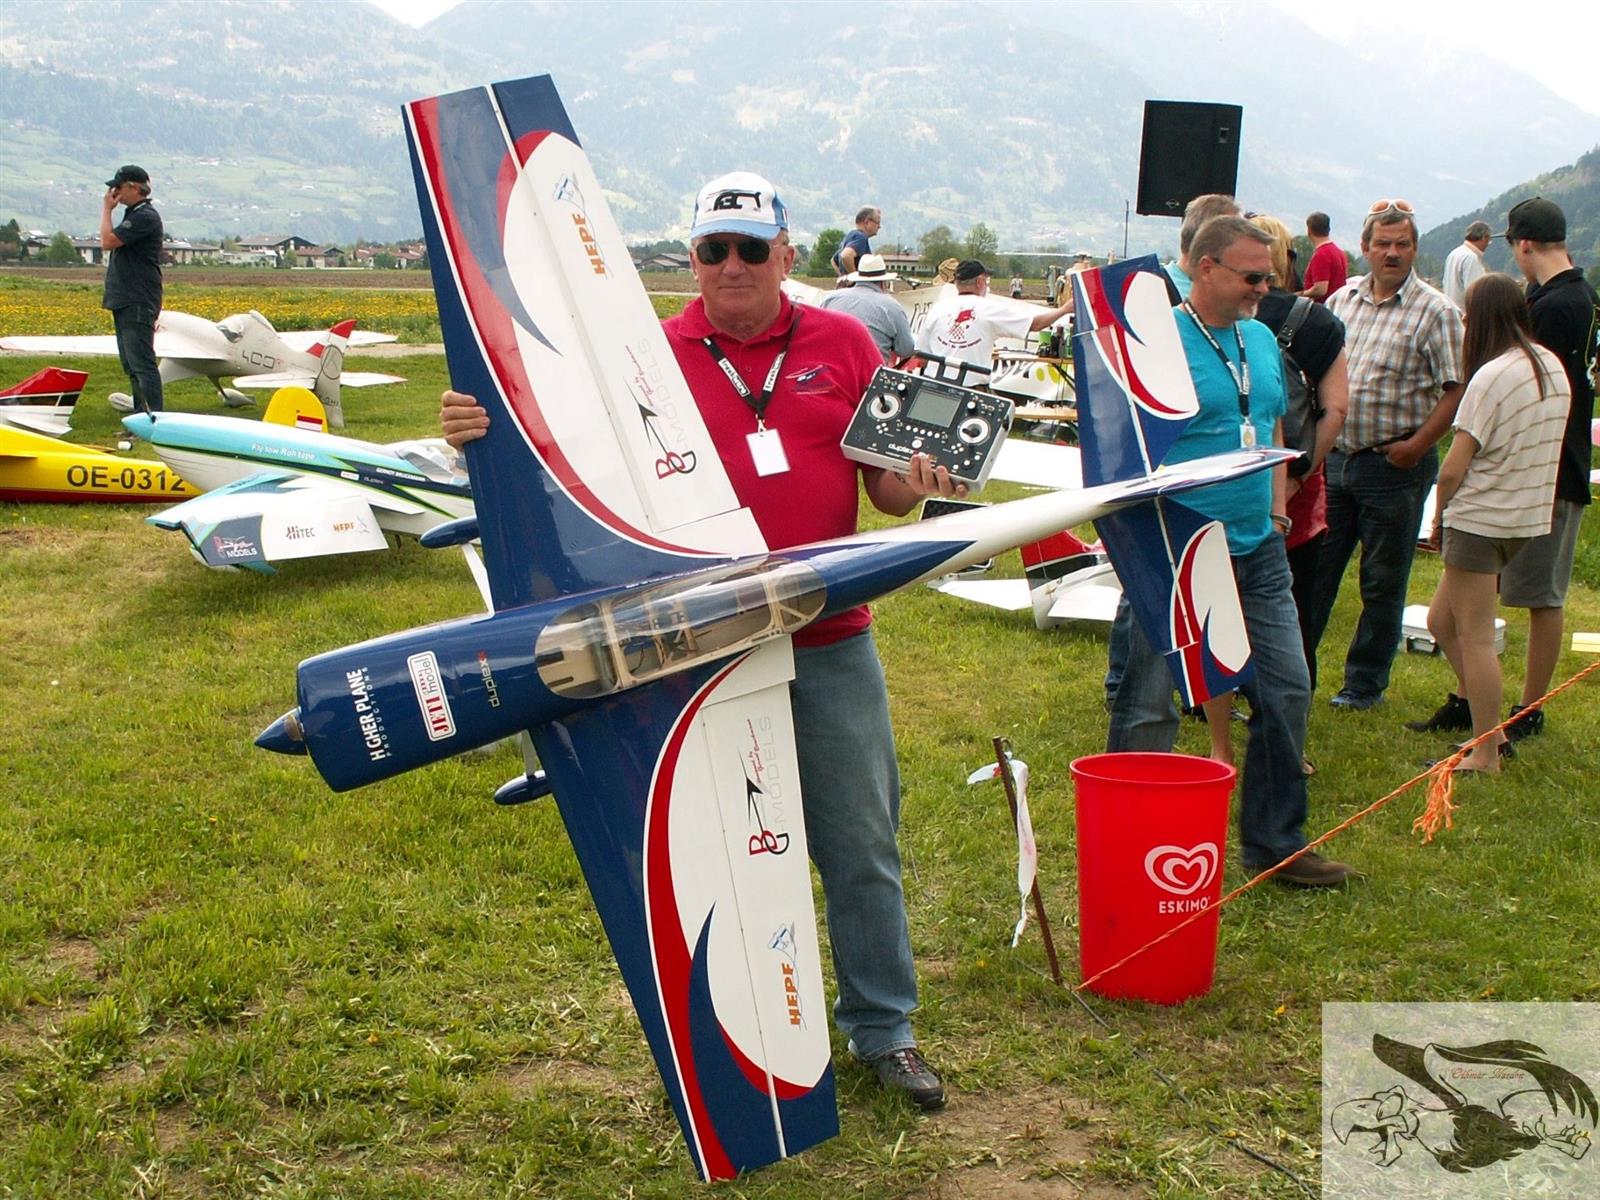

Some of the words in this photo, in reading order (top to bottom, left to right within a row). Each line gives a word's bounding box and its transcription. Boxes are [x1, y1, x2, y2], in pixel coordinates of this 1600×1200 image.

[570, 212, 606, 275] HEPF
[67, 465, 185, 491] OE-0312
[346, 668, 372, 713] PLANE
[480, 658, 500, 708] duplex
[425, 696, 449, 732] JETI
[1159, 897, 1208, 914] ESKIMO
[780, 962, 801, 1026] HEPF
